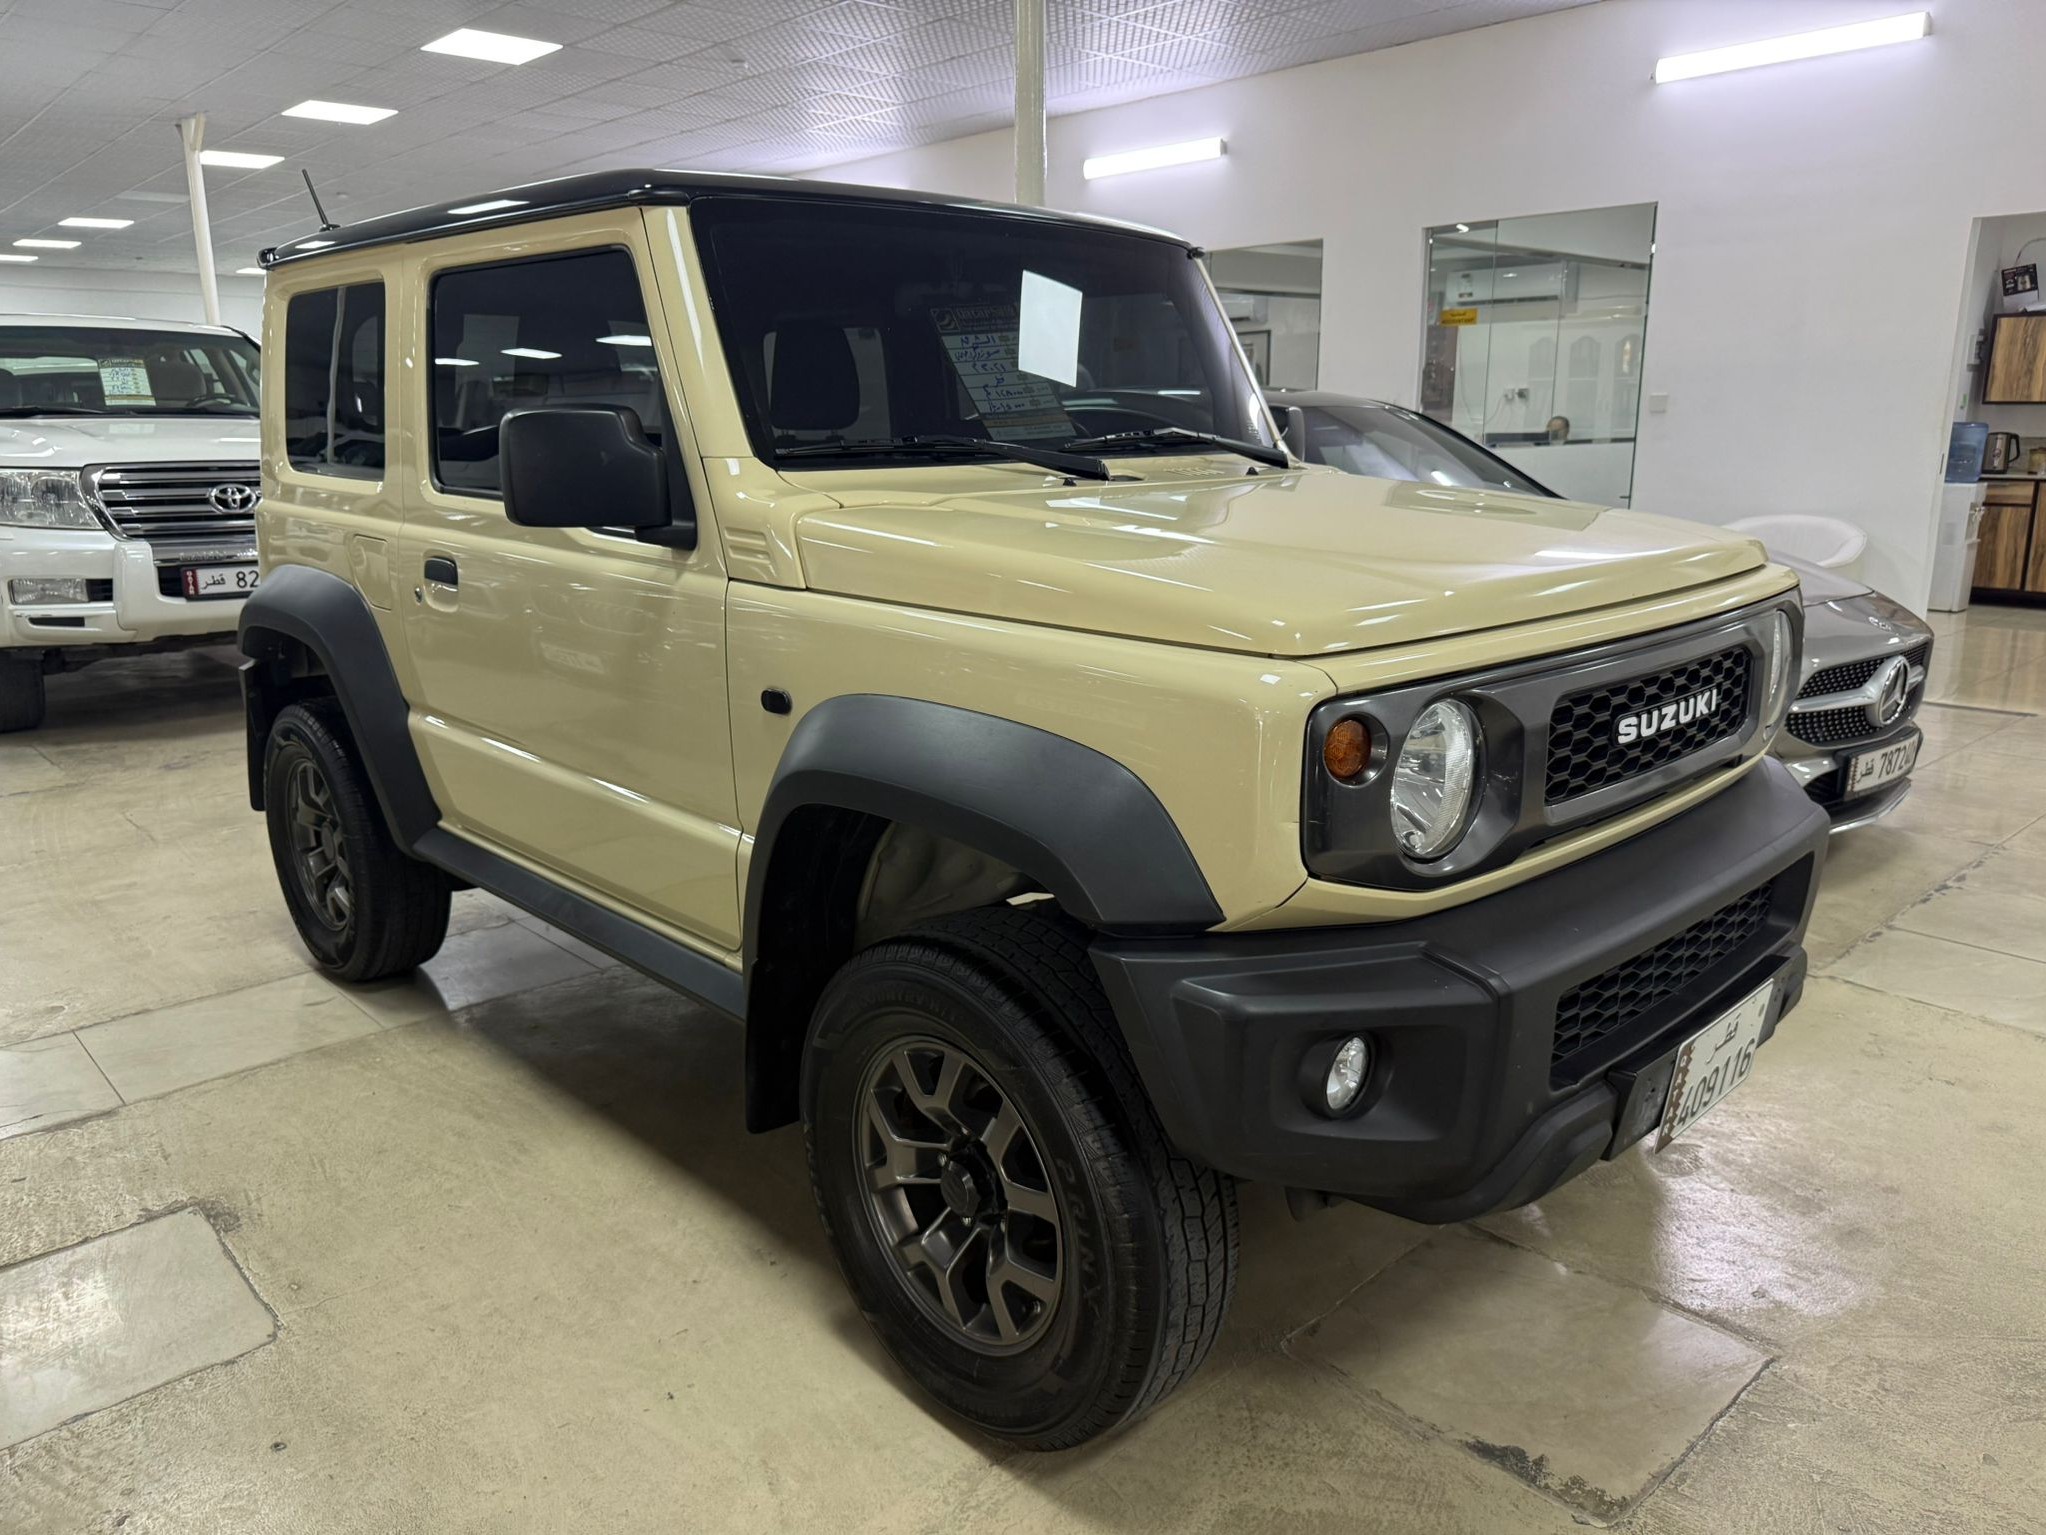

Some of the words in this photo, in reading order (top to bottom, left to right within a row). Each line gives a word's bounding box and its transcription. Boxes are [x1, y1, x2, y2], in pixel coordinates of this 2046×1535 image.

[201, 573, 226, 590] قطر
[1617, 688, 1718, 744] SUZUKI
[1856, 758, 1875, 783] قطر
[1705, 1012, 1742, 1065] قطر
[1662, 1055, 1687, 1137] QATAR
[1677, 1037, 1755, 1126] 409116
